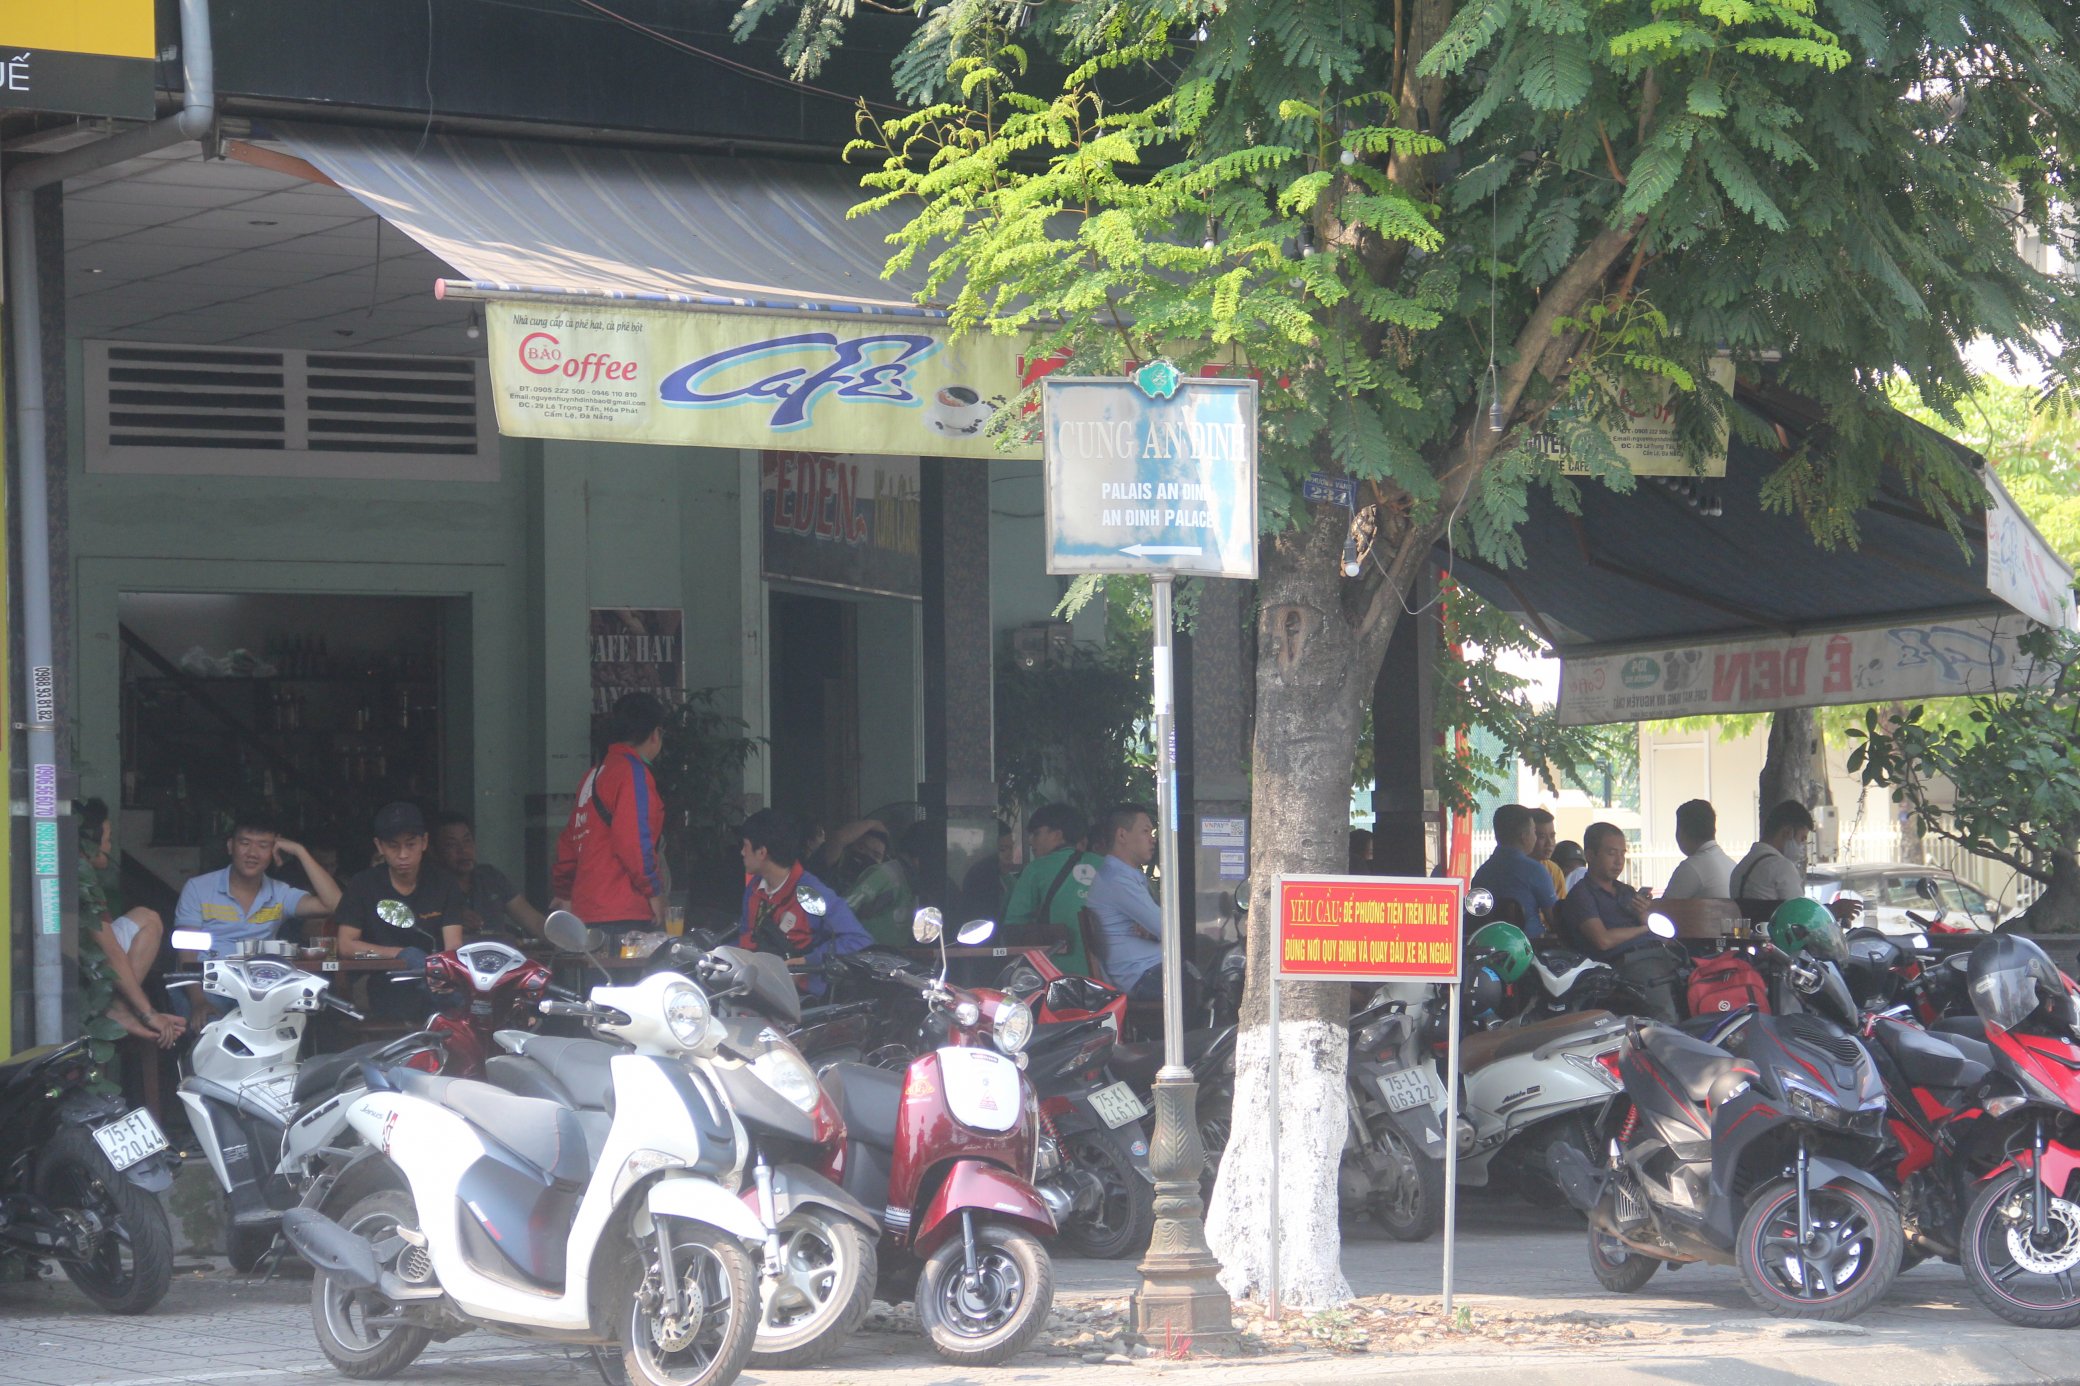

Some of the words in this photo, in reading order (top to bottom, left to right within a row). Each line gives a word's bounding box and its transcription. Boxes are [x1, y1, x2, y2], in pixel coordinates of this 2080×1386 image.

[530, 318, 547, 328] cung
[550, 314, 563, 328] cấp
[575, 318, 588, 331] phê
[617, 321, 630, 332] phê
[1058, 420, 1138, 459] CUNG
[1142, 421, 1185, 459] AN
[1102, 483, 1152, 500] PALAIS
[1157, 483, 1179, 500] AN
[1102, 509, 1121, 526] AN
[1290, 892, 1313, 922] YÊU
[1322, 939, 1337, 964] QUY
[1339, 940, 1356, 967] ĐỊNH
[1370, 941, 1388, 965] QUAY
[1407, 942, 1416, 964] XE
[1417, 942, 1428, 964] RA
[1390, 1085, 1435, 1109] 063.22
[111, 1130, 164, 1167] 520.44
